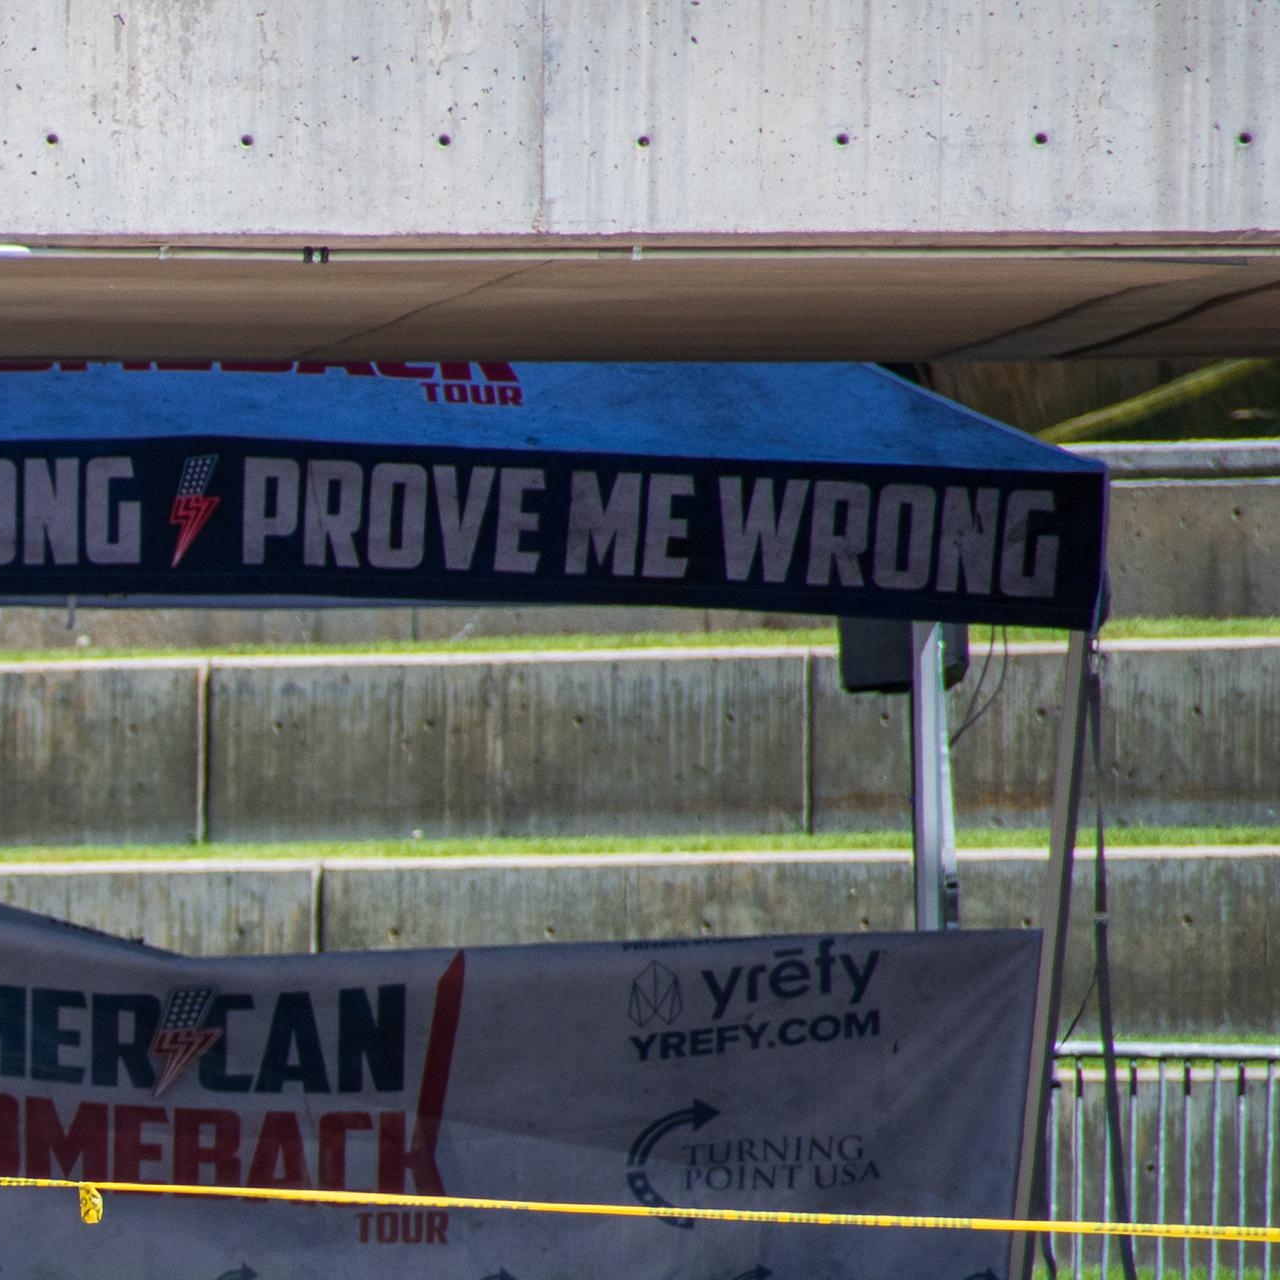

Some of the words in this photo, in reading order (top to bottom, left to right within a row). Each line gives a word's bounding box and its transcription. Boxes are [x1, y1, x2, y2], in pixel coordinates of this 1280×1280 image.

[420, 382, 523, 406] TOUR
[242, 457, 544, 574] PROVE
[564, 470, 695, 579] ME
[719, 476, 1060, 597] WRONG
[629, 1009, 880, 1061] YREFY.COM
[682, 1134, 864, 1168] TURNING
[681, 1161, 803, 1191] POINT
[814, 1160, 881, 1189] USA
[355, 1210, 449, 1245] TOUR
